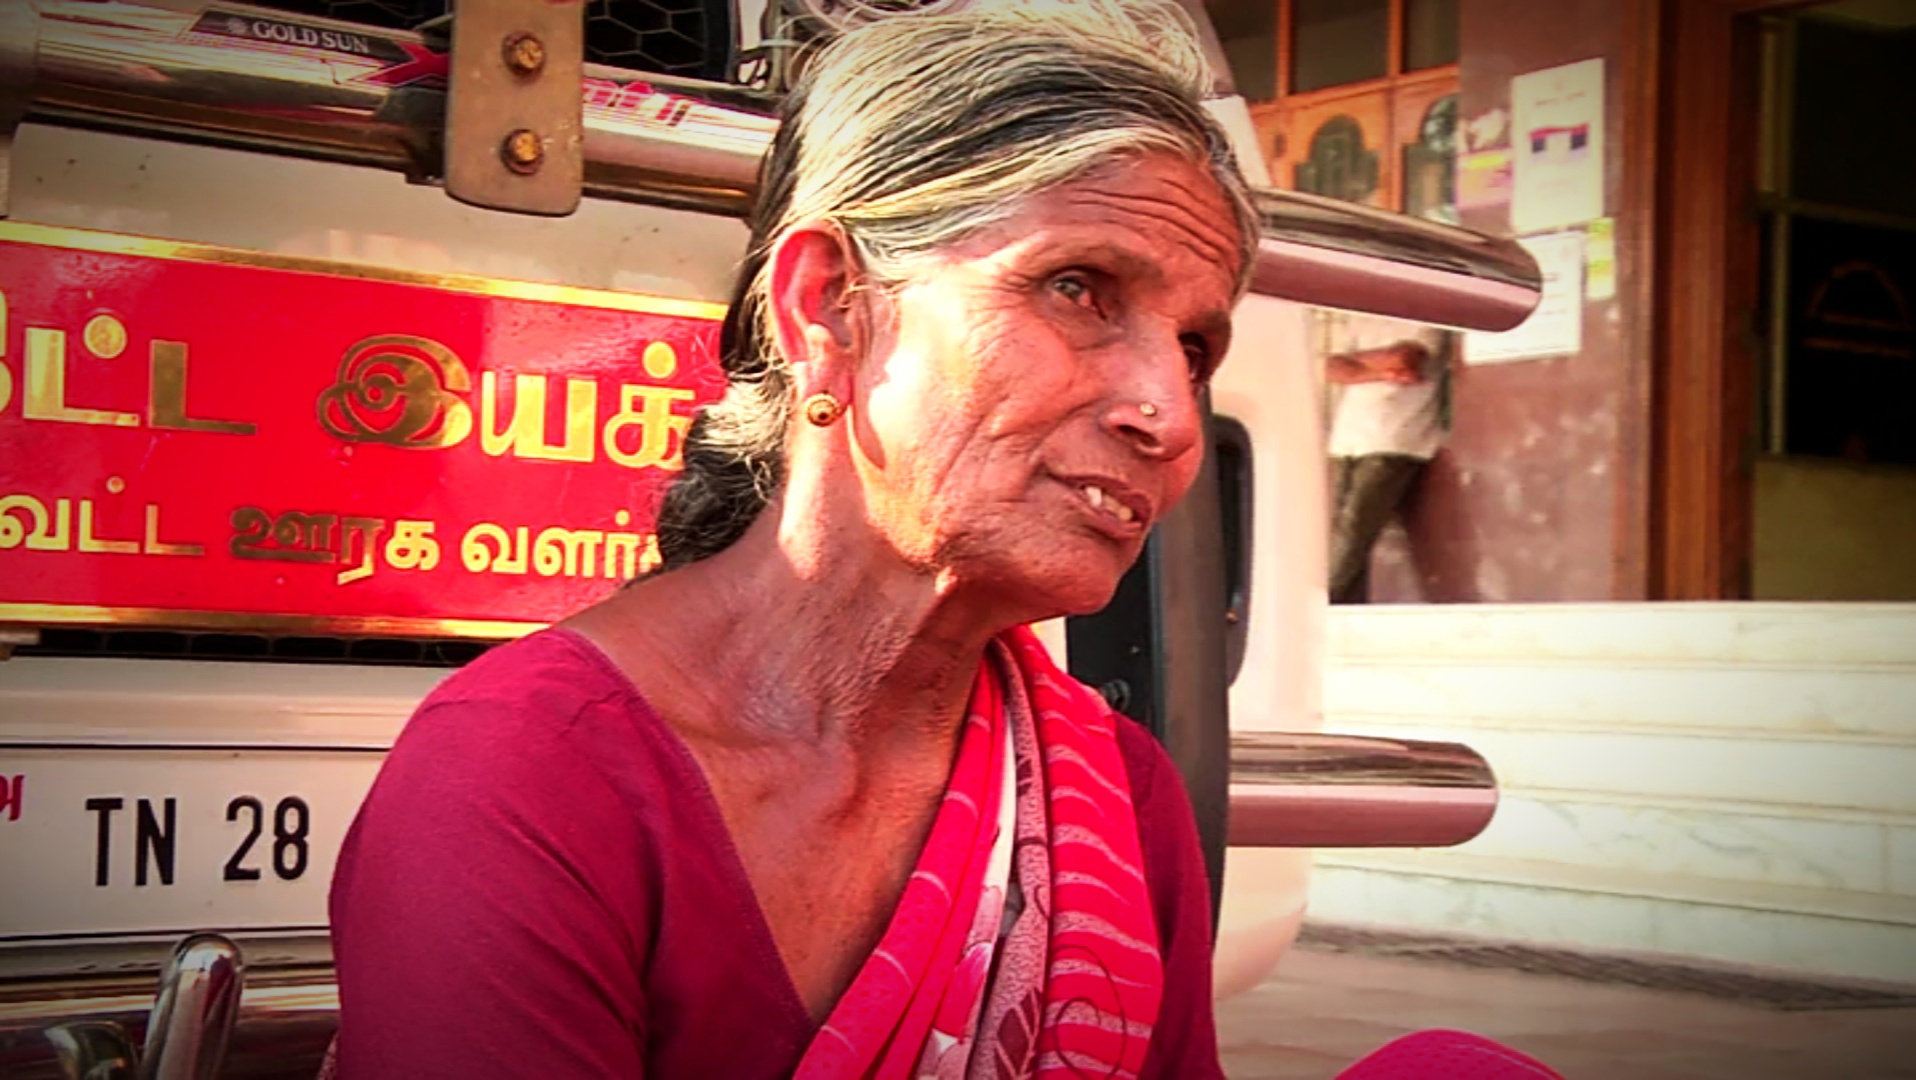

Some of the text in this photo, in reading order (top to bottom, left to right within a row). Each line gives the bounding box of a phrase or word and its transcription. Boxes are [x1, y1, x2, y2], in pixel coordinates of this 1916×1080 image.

[253, 21, 369, 52] GOLD SUN
[0, 289, 257, 436] ட்ட
[230, 506, 440, 585] ஊரக
[85, 798, 176, 886] TN
[223, 796, 310, 881] 28
